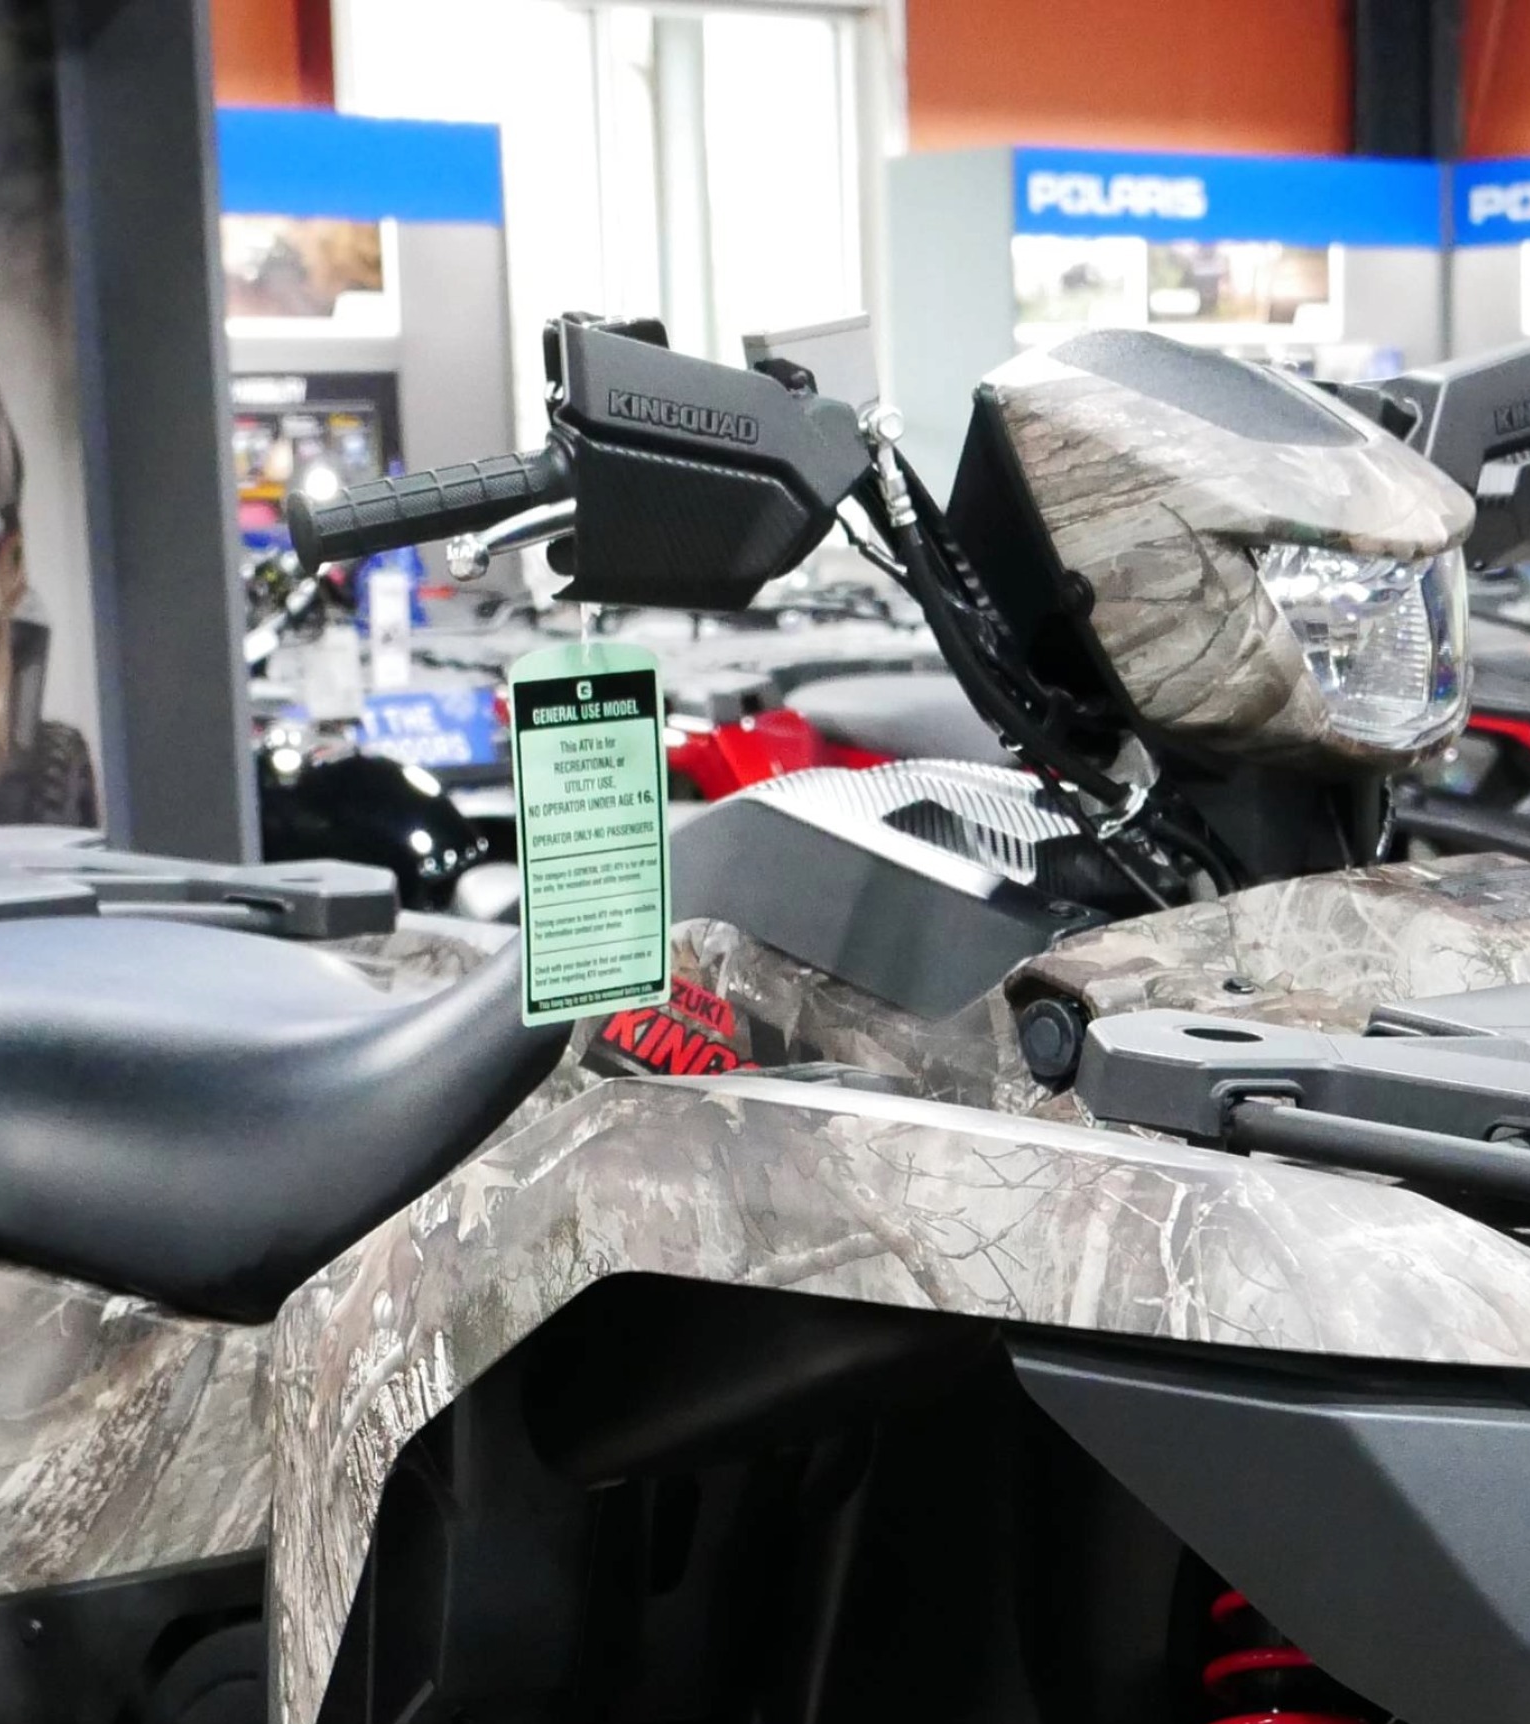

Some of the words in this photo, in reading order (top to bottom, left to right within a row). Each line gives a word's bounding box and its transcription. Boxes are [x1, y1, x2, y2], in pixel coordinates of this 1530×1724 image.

[1027, 172, 1208, 220] POLARIS
[608, 389, 759, 444] KINGQUAD
[532, 705, 579, 726] GENERAL
[580, 702, 601, 720] USE
[602, 699, 640, 717] MODEL
[560, 740, 578, 754] This
[579, 738, 595, 752] ATV
[596, 736, 605, 750] is
[553, 757, 616, 774] RECREATIONAL
[564, 778, 596, 794] UTILITY
[528, 805, 541, 819] NO
[542, 799, 586, 817] OPERATOR
[588, 795, 617, 811] UNDER
[618, 792, 635, 807] AGE
[532, 832, 572, 848] OPERATOR
[606, 821, 655, 838] PASSENGERS
[602, 1008, 760, 1075] KING
